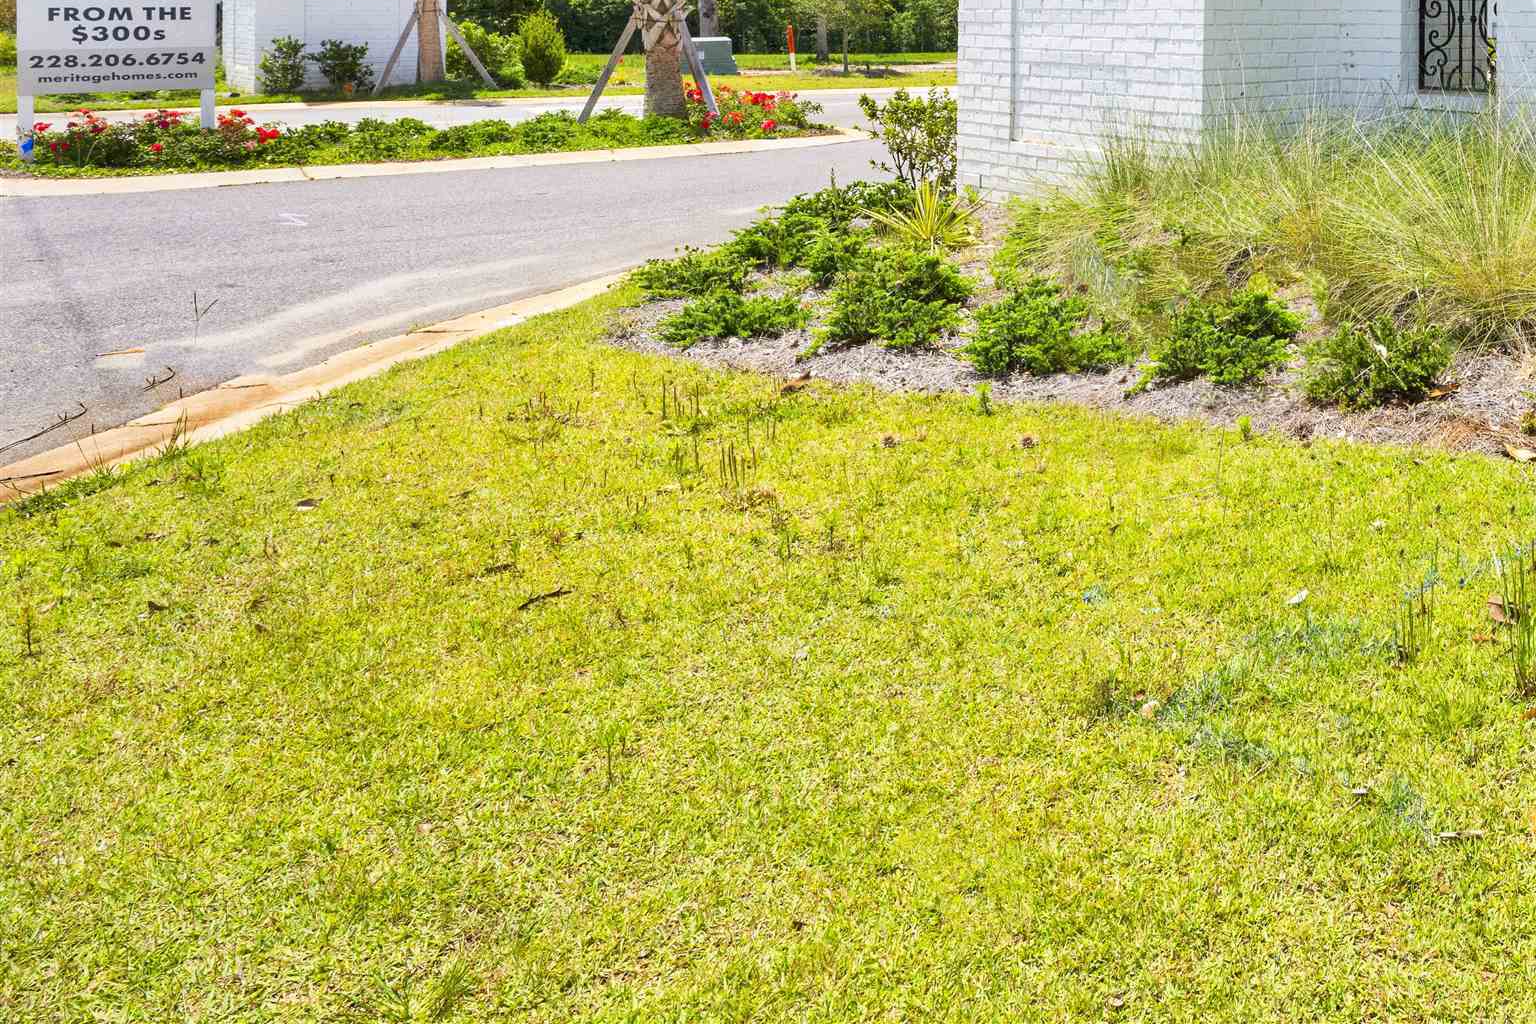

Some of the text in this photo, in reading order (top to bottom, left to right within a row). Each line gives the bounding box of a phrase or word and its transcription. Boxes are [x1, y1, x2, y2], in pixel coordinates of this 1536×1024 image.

[48, 6, 192, 22] FROM THE
[72, 24, 166, 45] $300s
[30, 51, 206, 69] 228.206.6754
[38, 70, 198, 84] meritagehomes.com
